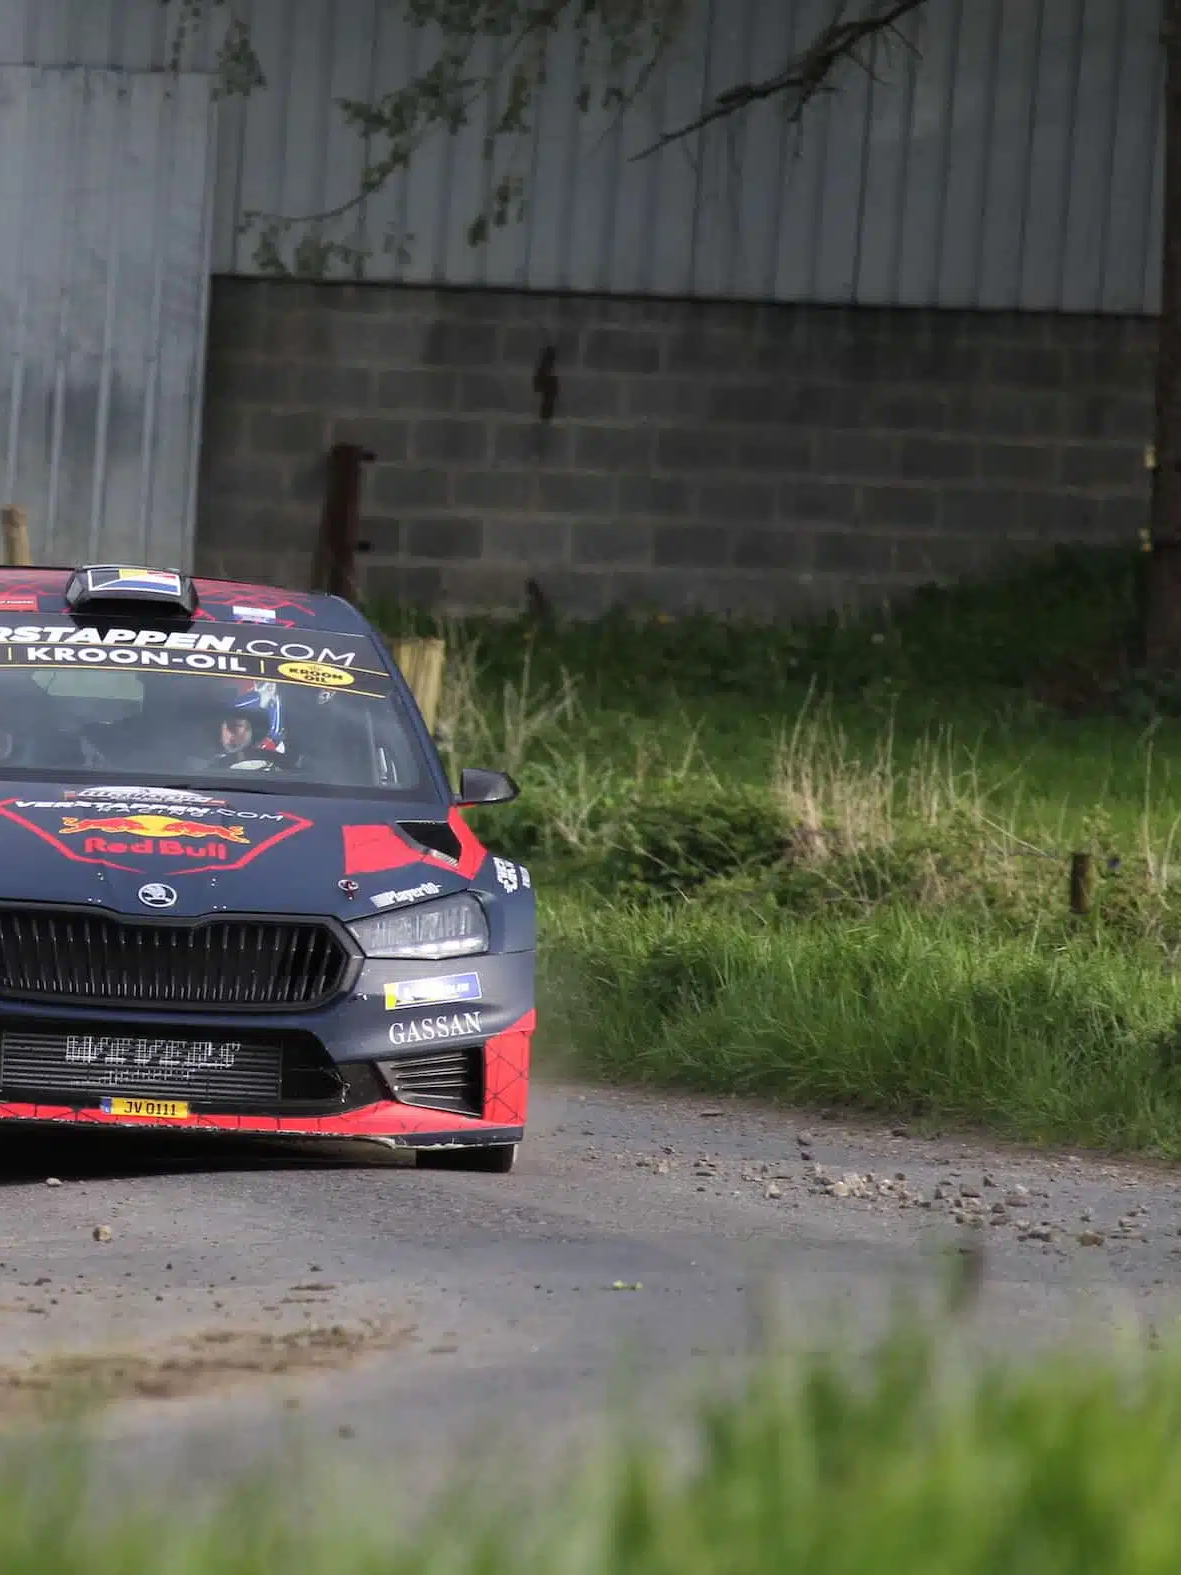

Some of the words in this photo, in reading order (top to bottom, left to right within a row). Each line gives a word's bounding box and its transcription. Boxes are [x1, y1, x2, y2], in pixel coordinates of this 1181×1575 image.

[26, 646, 247, 672] KROON-OIL
[288, 667, 344, 681] KROON
[304, 675, 327, 683] OIL
[84, 837, 154, 855] Red
[159, 838, 228, 861] Bull
[388, 1011, 483, 1045] GASSAN
[123, 1101, 143, 1113] JV
[146, 1103, 176, 1115] 0111
